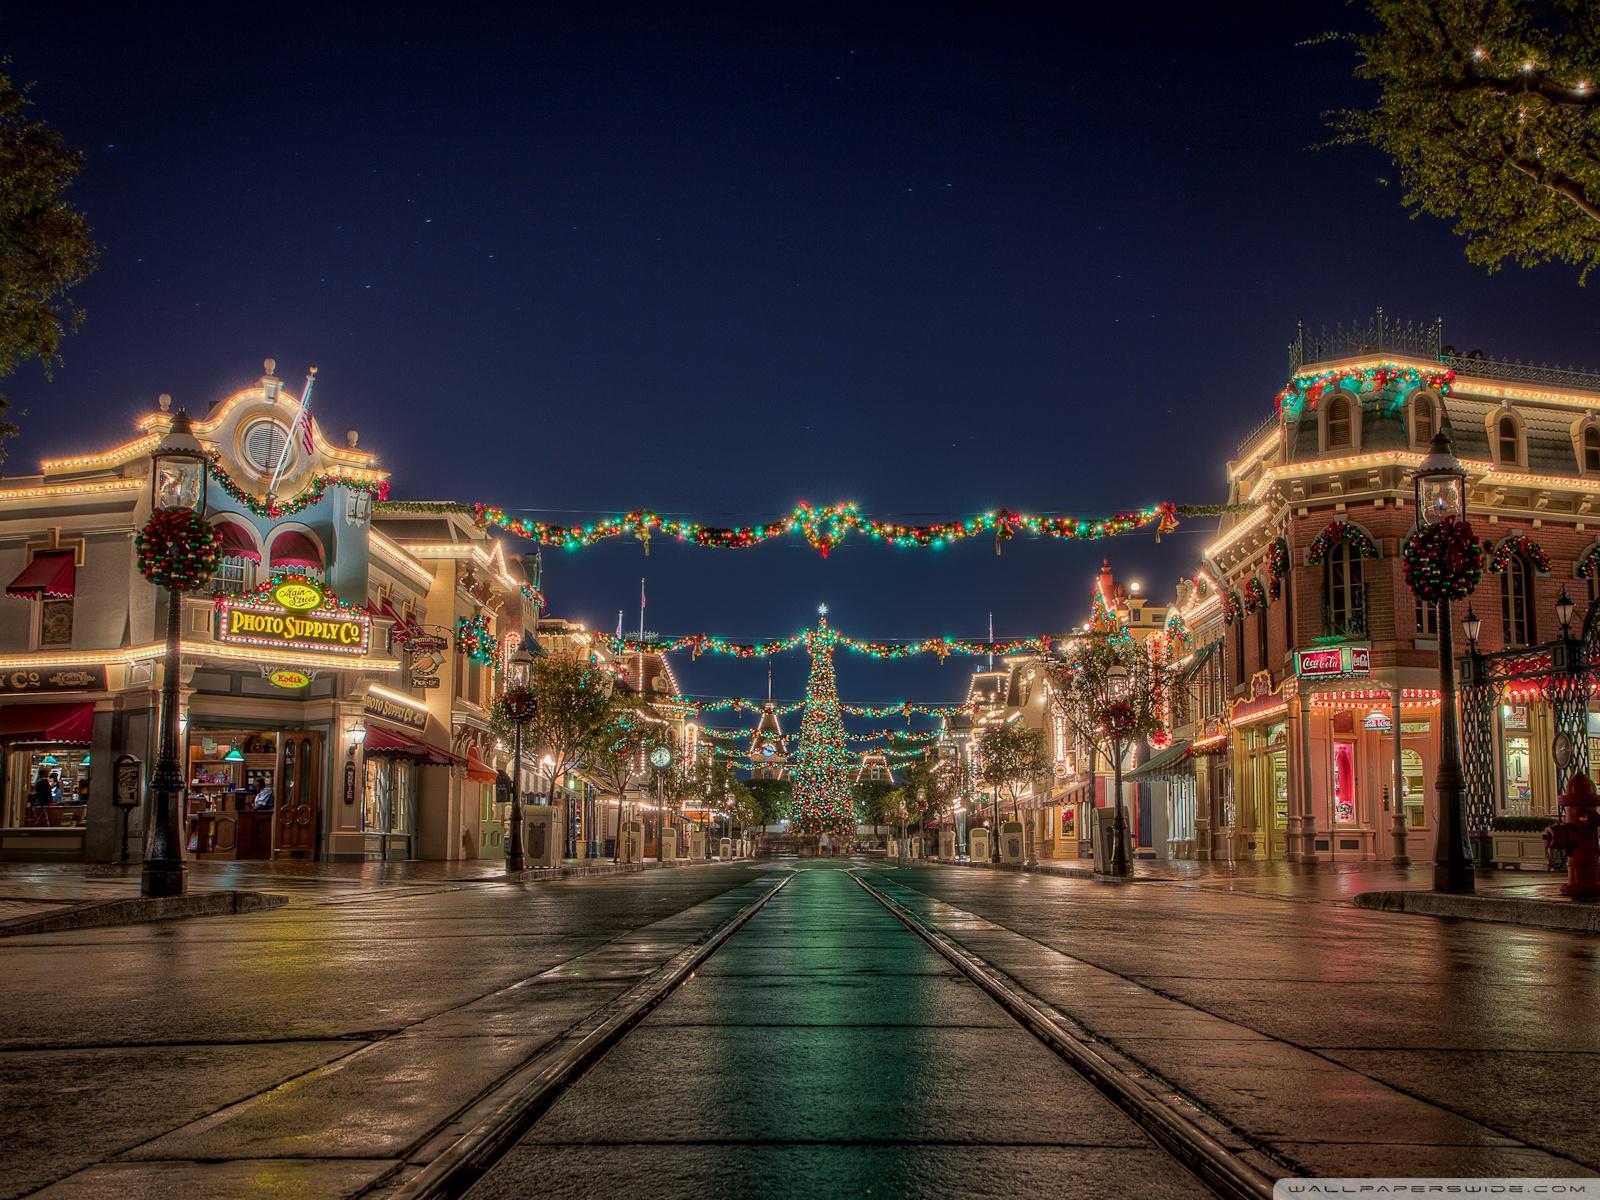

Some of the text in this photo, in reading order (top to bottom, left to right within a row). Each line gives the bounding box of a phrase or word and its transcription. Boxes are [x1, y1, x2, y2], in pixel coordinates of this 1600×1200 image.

[280, 587, 305, 599] Main
[290, 595, 316, 607] Street
[231, 610, 284, 633] PHOTO
[284, 616, 340, 639] SUPPLY
[277, 674, 302, 684] Kodak
